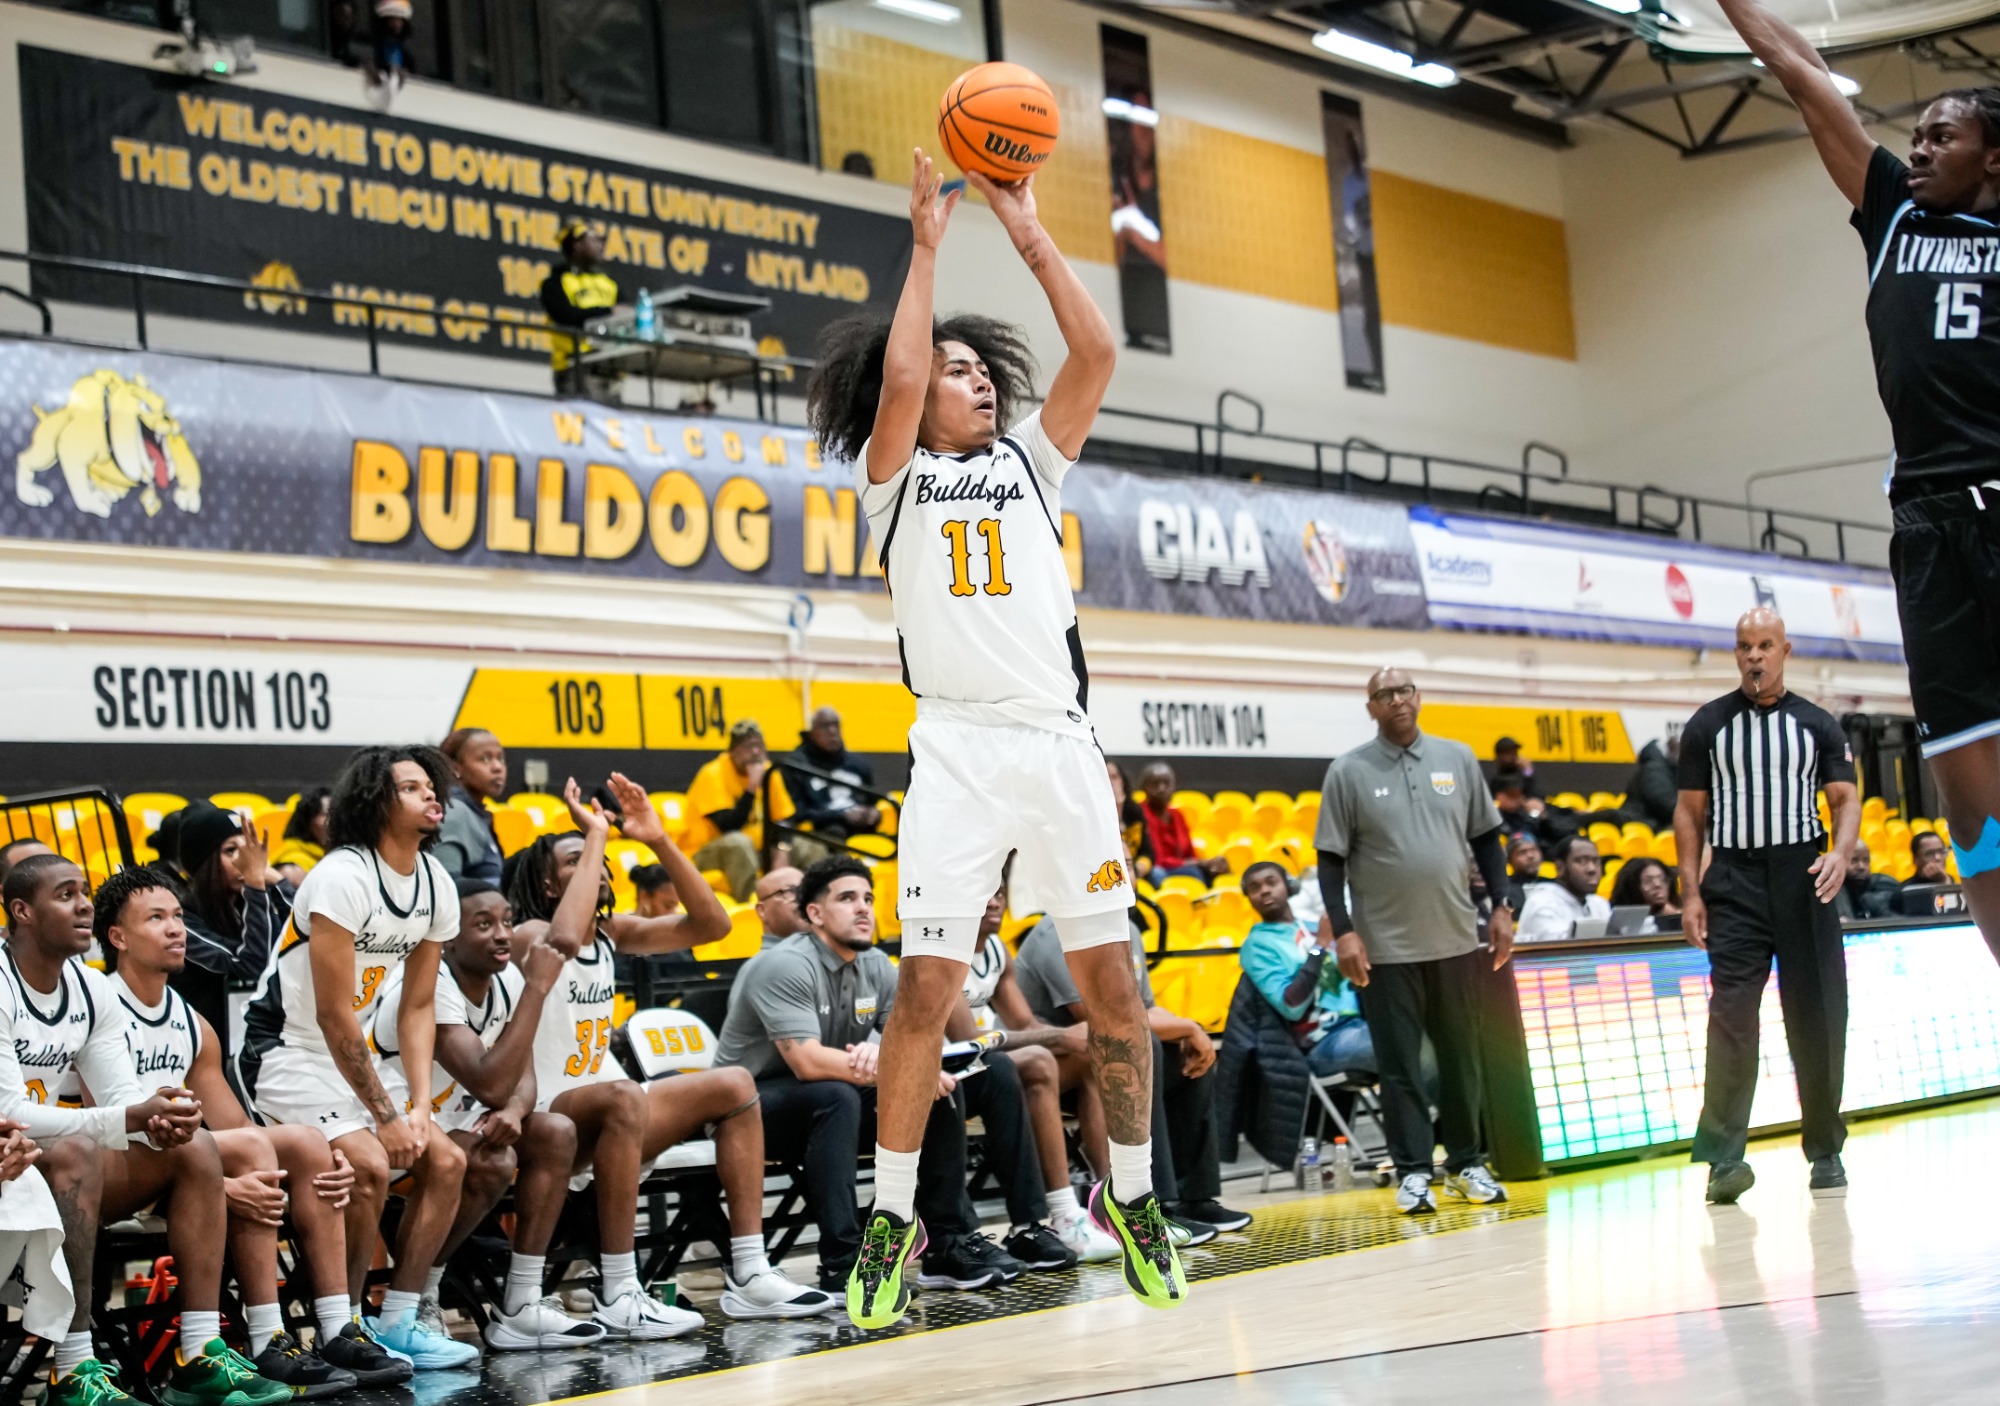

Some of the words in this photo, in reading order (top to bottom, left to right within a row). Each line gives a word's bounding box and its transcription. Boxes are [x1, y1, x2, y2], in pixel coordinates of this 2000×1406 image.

[177, 92, 368, 167] WELCOME
[373, 128, 424, 175] TO
[429, 141, 543, 197] BOWIE
[548, 162, 651, 218] STATE
[652, 183, 820, 248] UNIVERSITY
[112, 137, 192, 190] THE
[198, 153, 343, 214] OLDEST
[350, 178, 447, 232] HBCU
[453, 193, 490, 240] IN
[495, 203, 560, 251] THE
[668, 234, 710, 276] OF
[332, 282, 437, 337] HOME
[442, 298, 490, 343] OF
[1934, 282, 1982, 340] 15
[553, 411, 821, 470] WELCOME
[350, 438, 772, 573] BULLDOG
[941, 518, 1012, 597] 11
[1139, 501, 1271, 588] CIAA
[94, 666, 256, 730] SECTION
[265, 672, 331, 731] 103
[548, 680, 604, 735] 103
[675, 685, 725, 738] 104
[1142, 701, 1228, 746] SECTION
[1231, 704, 1266, 748] 104
[1536, 715, 1563, 753] 104
[1580, 716, 1607, 753] 105
[564, 1016, 610, 1077] 35
[642, 1025, 705, 1057] BSU
